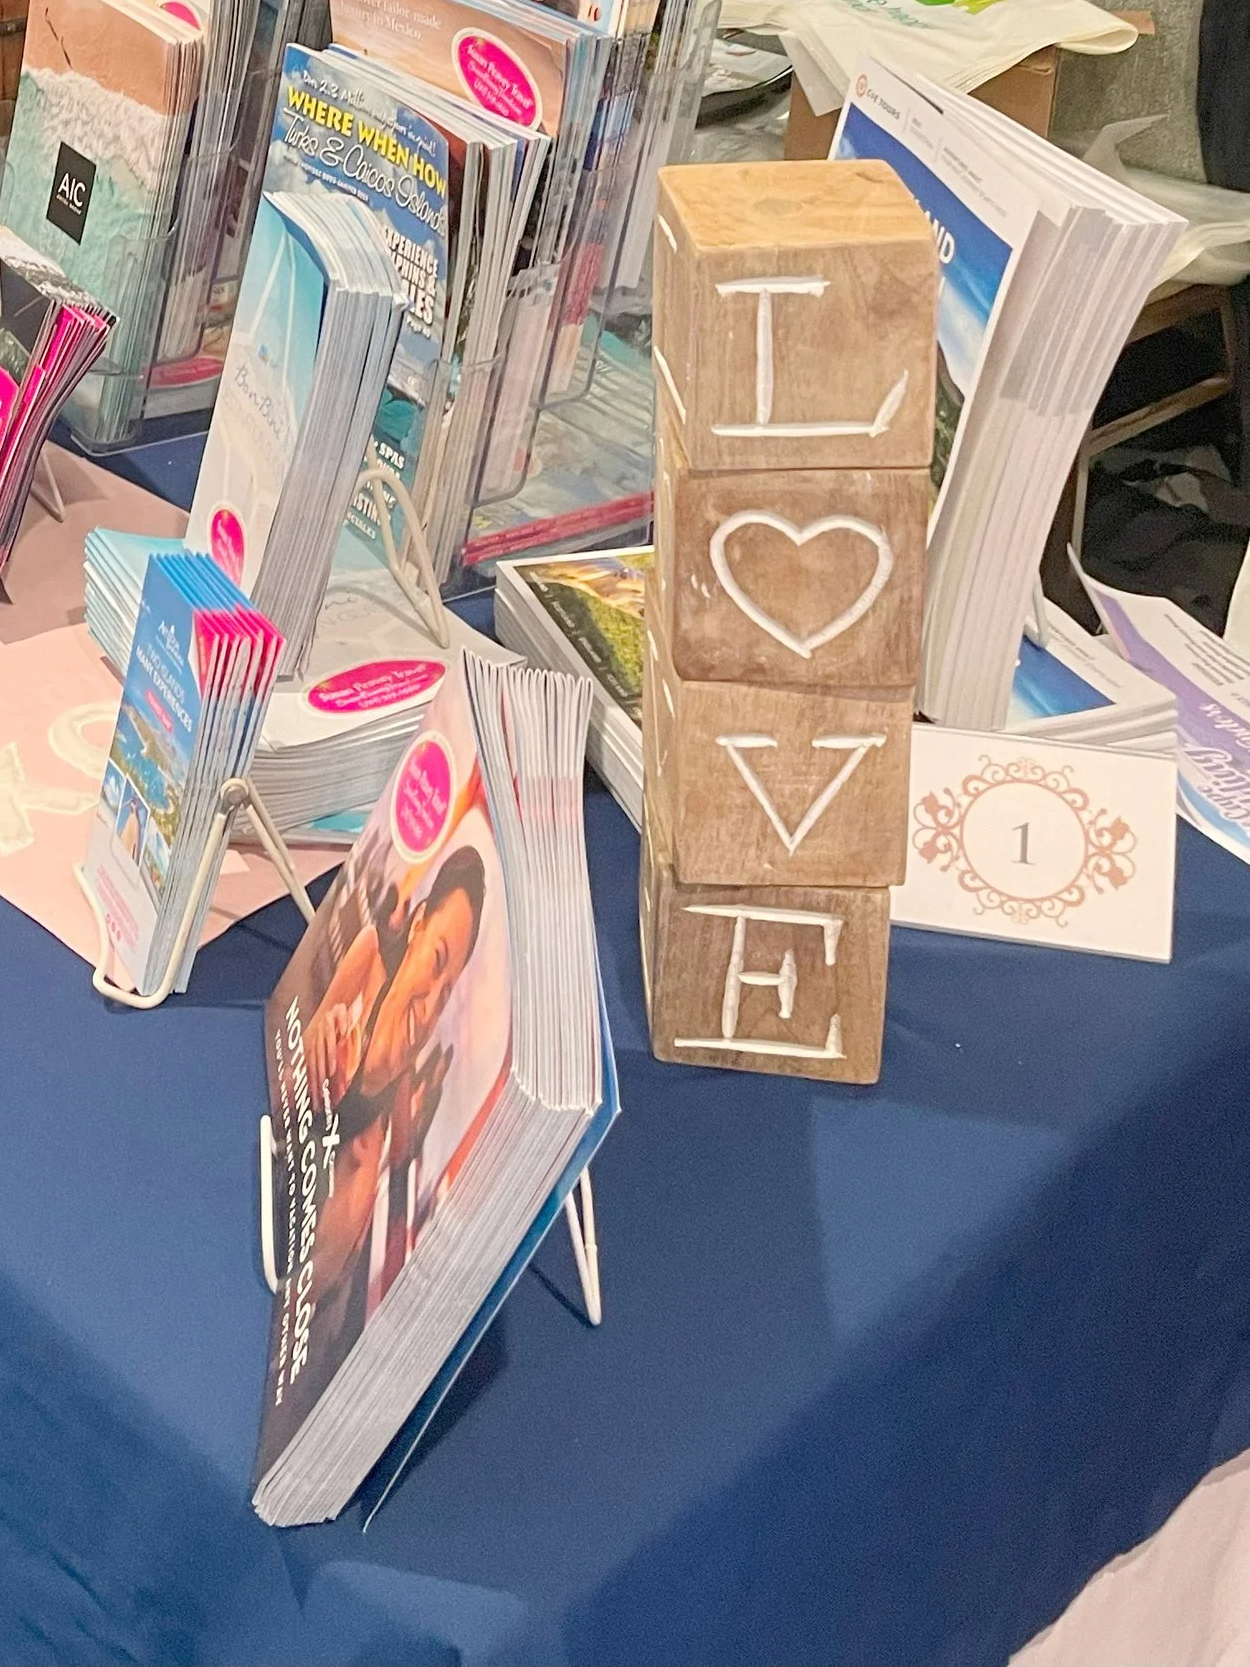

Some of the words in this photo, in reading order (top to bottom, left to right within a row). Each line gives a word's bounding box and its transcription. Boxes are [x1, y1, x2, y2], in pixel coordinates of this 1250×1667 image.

[373, 11, 384, 26] in
[878, 97, 901, 121] TOURS
[283, 107, 319, 157] Turks
[320, 137, 345, 167] &
[344, 145, 395, 199] Caicos
[287, 86, 354, 137] WHERE
[357, 120, 410, 170] WHEN
[412, 154, 447, 199] HOW
[57, 173, 86, 207] AIC
[394, 254, 426, 290] PHINS
[378, 442, 405, 470] SPAS
[153, 671, 193, 733] EXPERIENCES
[715, 734, 887, 855] V
[1010, 822, 1033, 865] 1
[674, 904, 847, 1059] E
[286, 996, 313, 1144] NOTHING
[286, 1129, 295, 1172] WANT
[288, 1172, 296, 1196] TO
[300, 1140, 317, 1264] COMES
[286, 1197, 296, 1274] VACATION
[279, 1312, 290, 1369] OTHER
[290, 1260, 314, 1385] CLOSE
